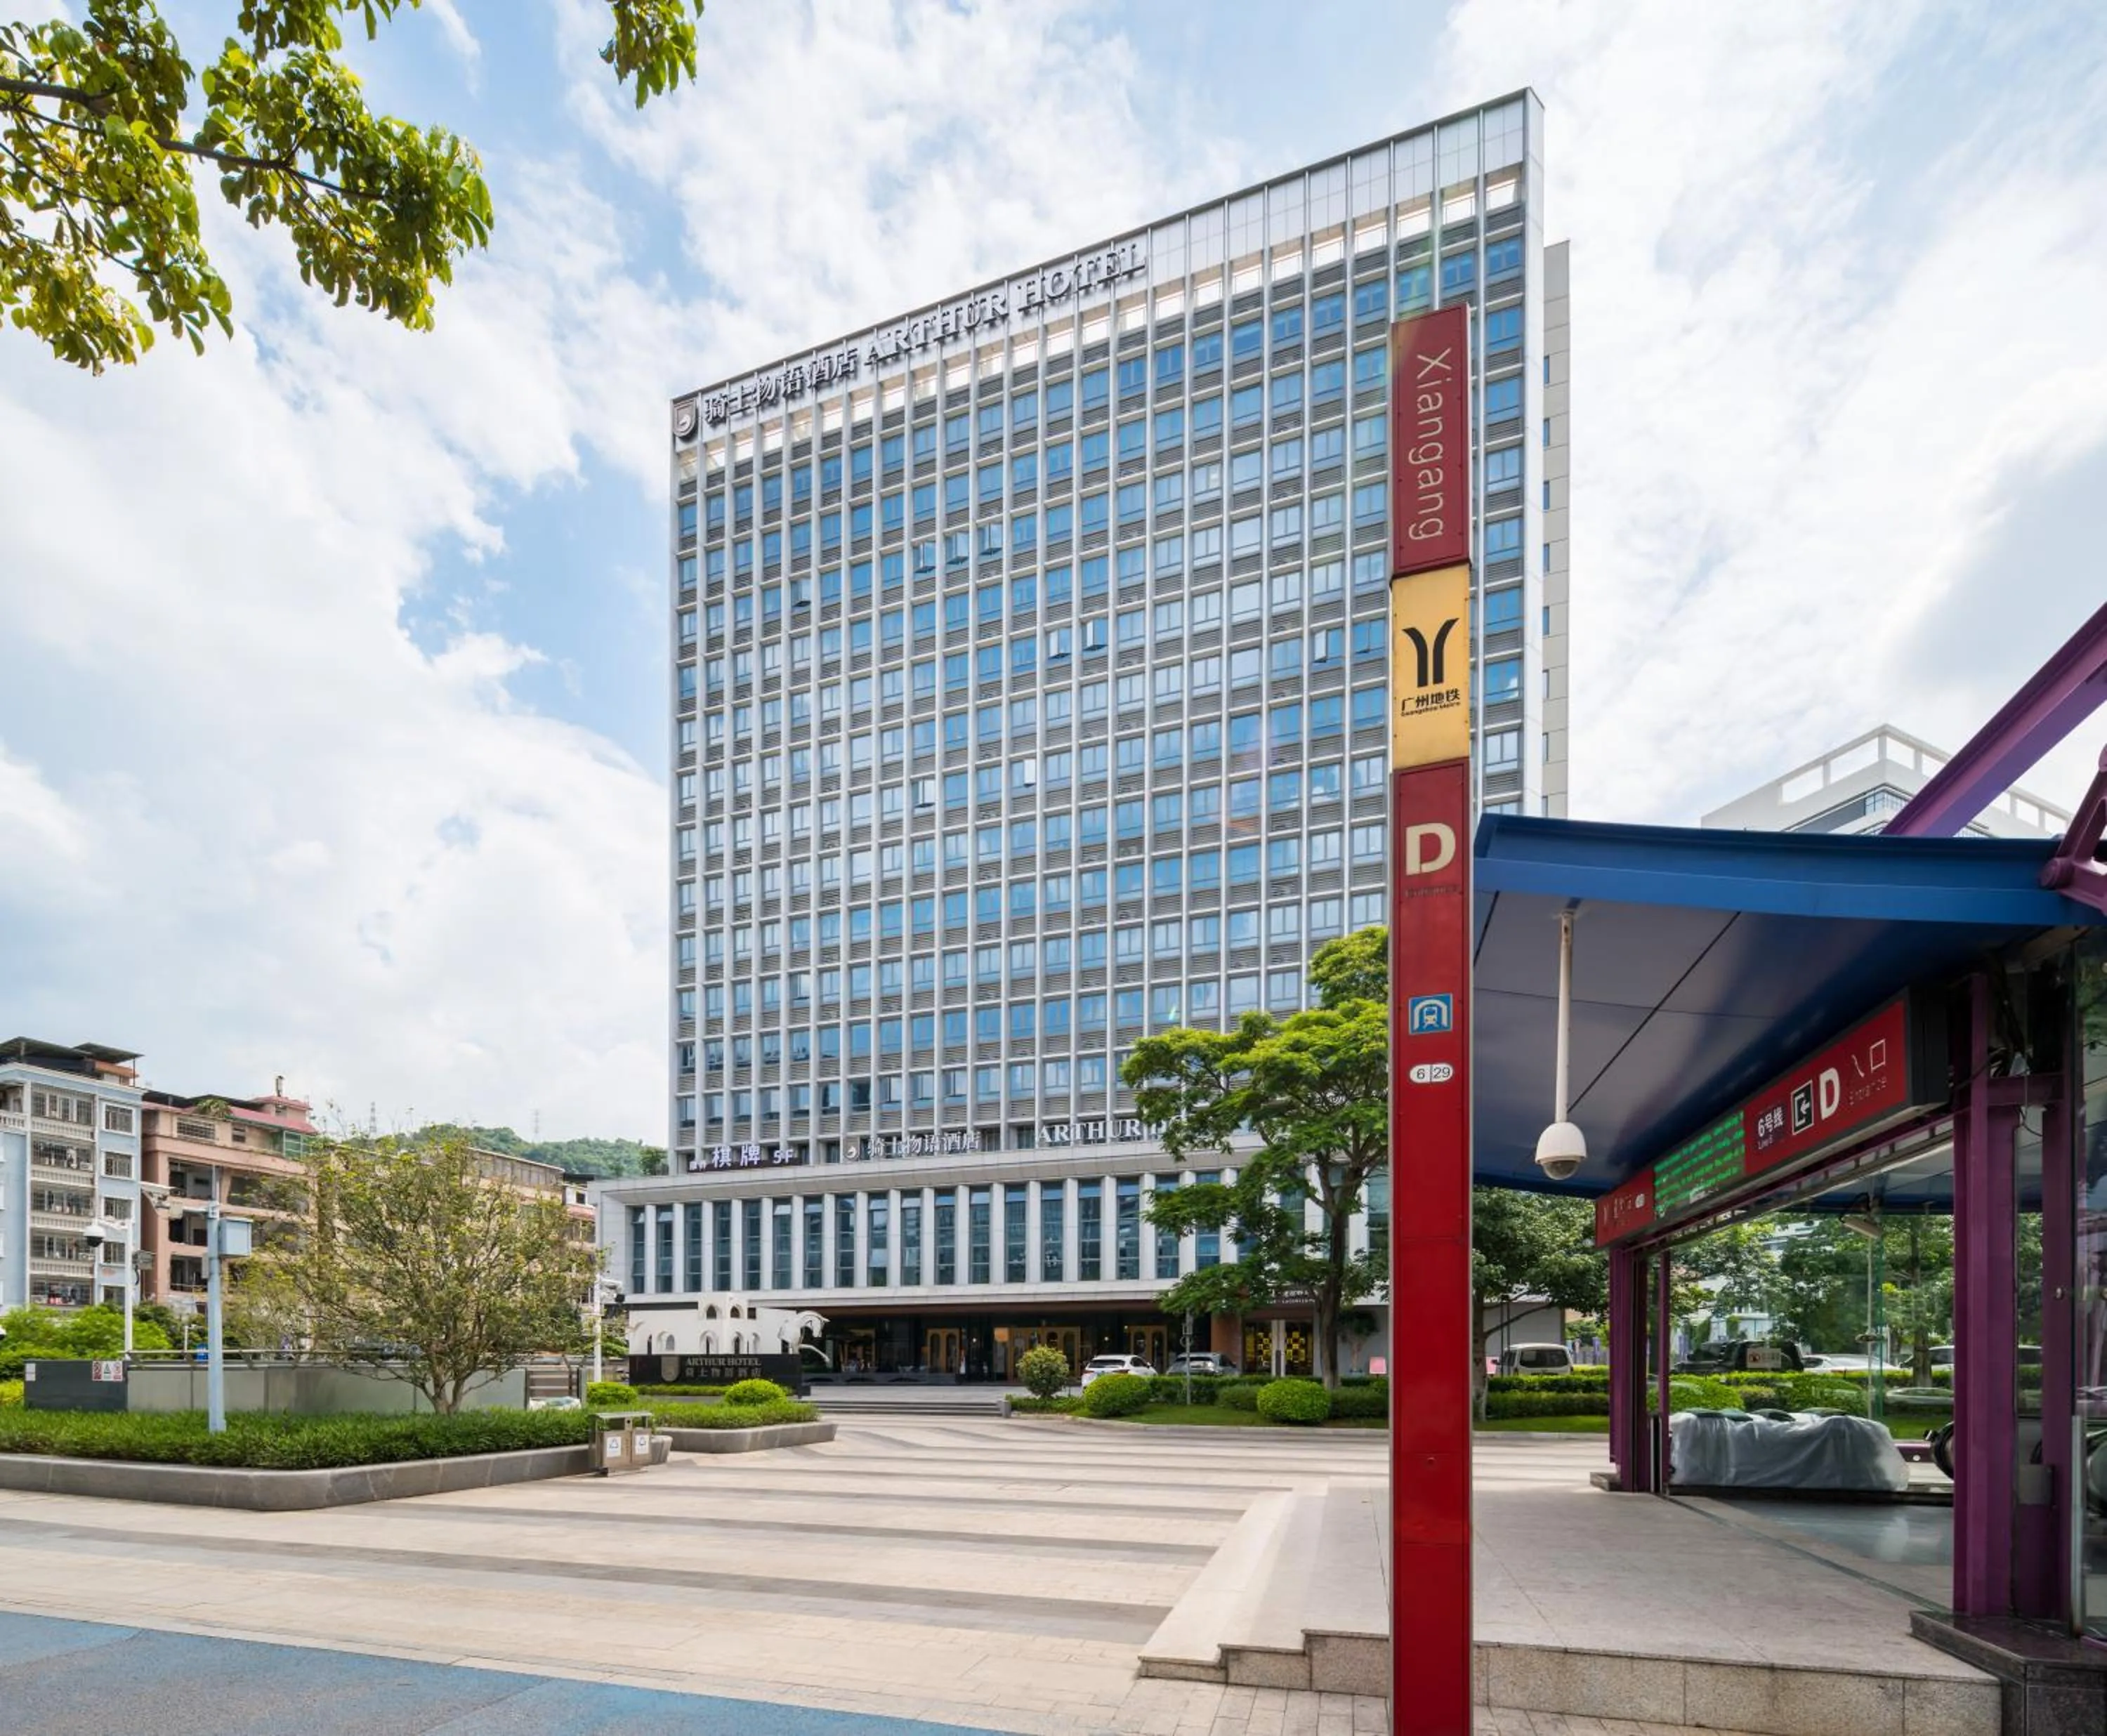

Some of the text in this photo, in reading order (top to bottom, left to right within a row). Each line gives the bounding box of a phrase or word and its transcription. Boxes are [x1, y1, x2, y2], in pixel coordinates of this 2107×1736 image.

[864, 242, 1146, 367] ARTHUR HOTEL
[704, 348, 858, 426] 骑士物语酒店
[1408, 348, 1452, 541] Xiangang
[1401, 688, 1460, 711] 广州地铁
[1405, 822, 1456, 876] D
[1417, 1067, 1450, 1079] 6 29
[1819, 1067, 1840, 1120] D
[1038, 1119, 1143, 1143] ARTHUR
[1758, 1106, 1784, 1138] 6号线
[712, 1143, 761, 1169] 棋牌
[773, 1148, 794, 1164] 5F
[686, 1357, 726, 1366] ARTHUR
